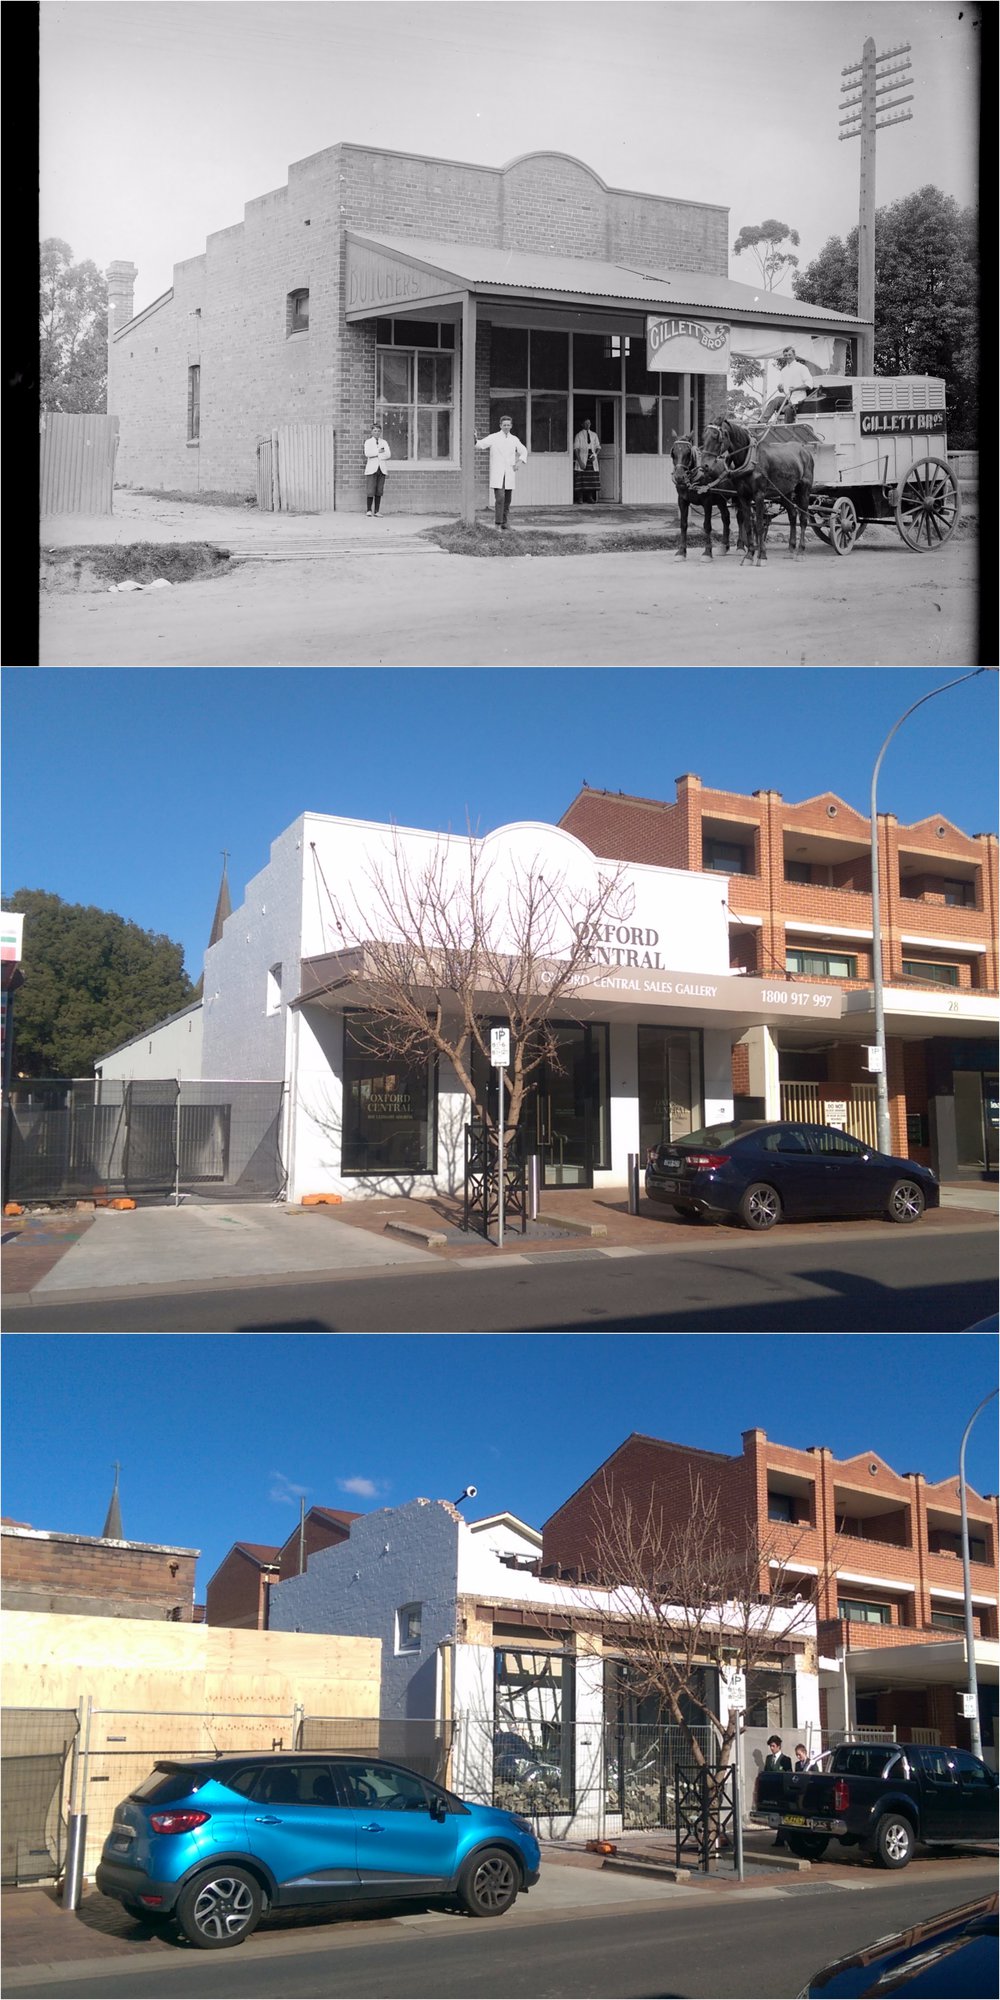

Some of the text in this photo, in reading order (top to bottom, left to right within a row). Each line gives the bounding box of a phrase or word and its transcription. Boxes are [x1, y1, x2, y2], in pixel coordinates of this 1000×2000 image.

[651, 320, 699, 350] GILLETT
[862, 415, 915, 432] GILLETT
[575, 921, 659, 947] OXFORD
[570, 943, 666, 970] CENTRAL
[594, 976, 641, 991] CENTRAL
[644, 980, 672, 993] SALES
[675, 983, 718, 997] GALLERY
[761, 989, 832, 1008] 1800 917 997
[949, 1001, 958, 1011] 28
[495, 1030, 506, 1040] 1P
[370, 1094, 411, 1103] OXFORD
[367, 1104, 413, 1112] CENTRAL
